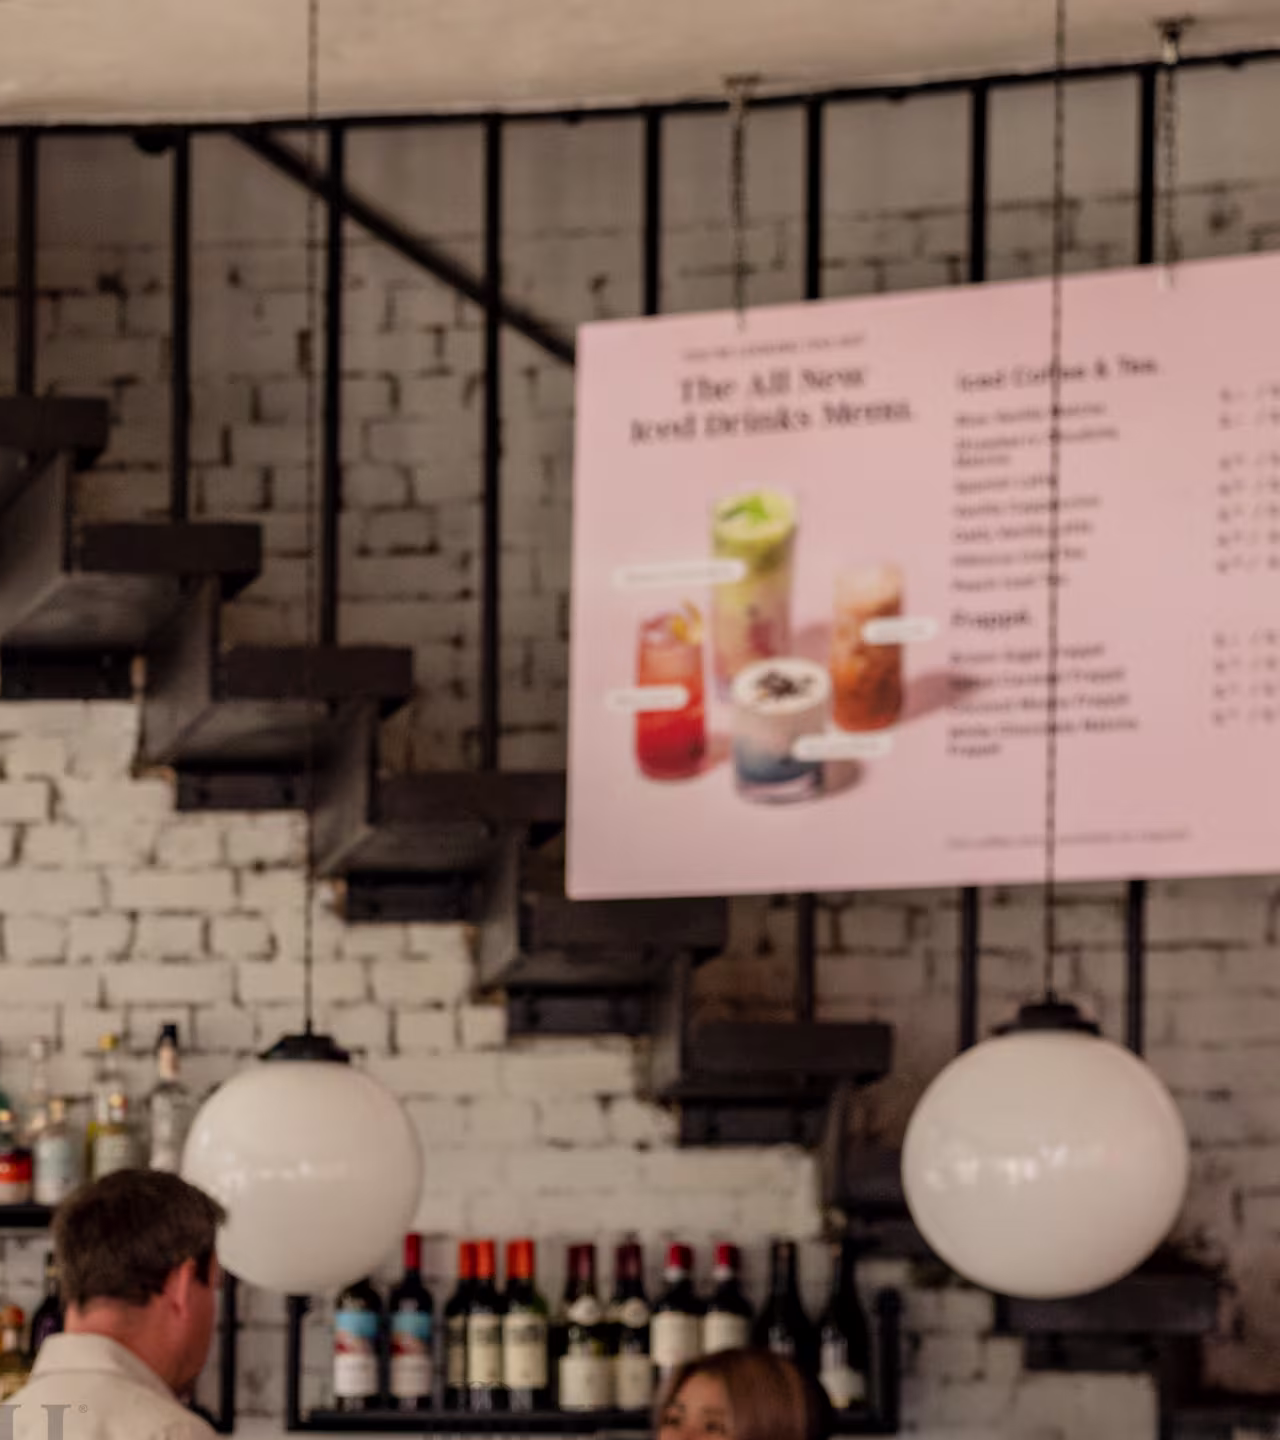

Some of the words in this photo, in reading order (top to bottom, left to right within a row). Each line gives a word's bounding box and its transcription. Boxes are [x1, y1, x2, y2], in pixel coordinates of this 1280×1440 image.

[681, 376, 735, 403] The
[749, 369, 791, 396] All
[800, 366, 865, 390] New
[629, 414, 697, 446] Iced
[703, 405, 812, 437] Drinks
